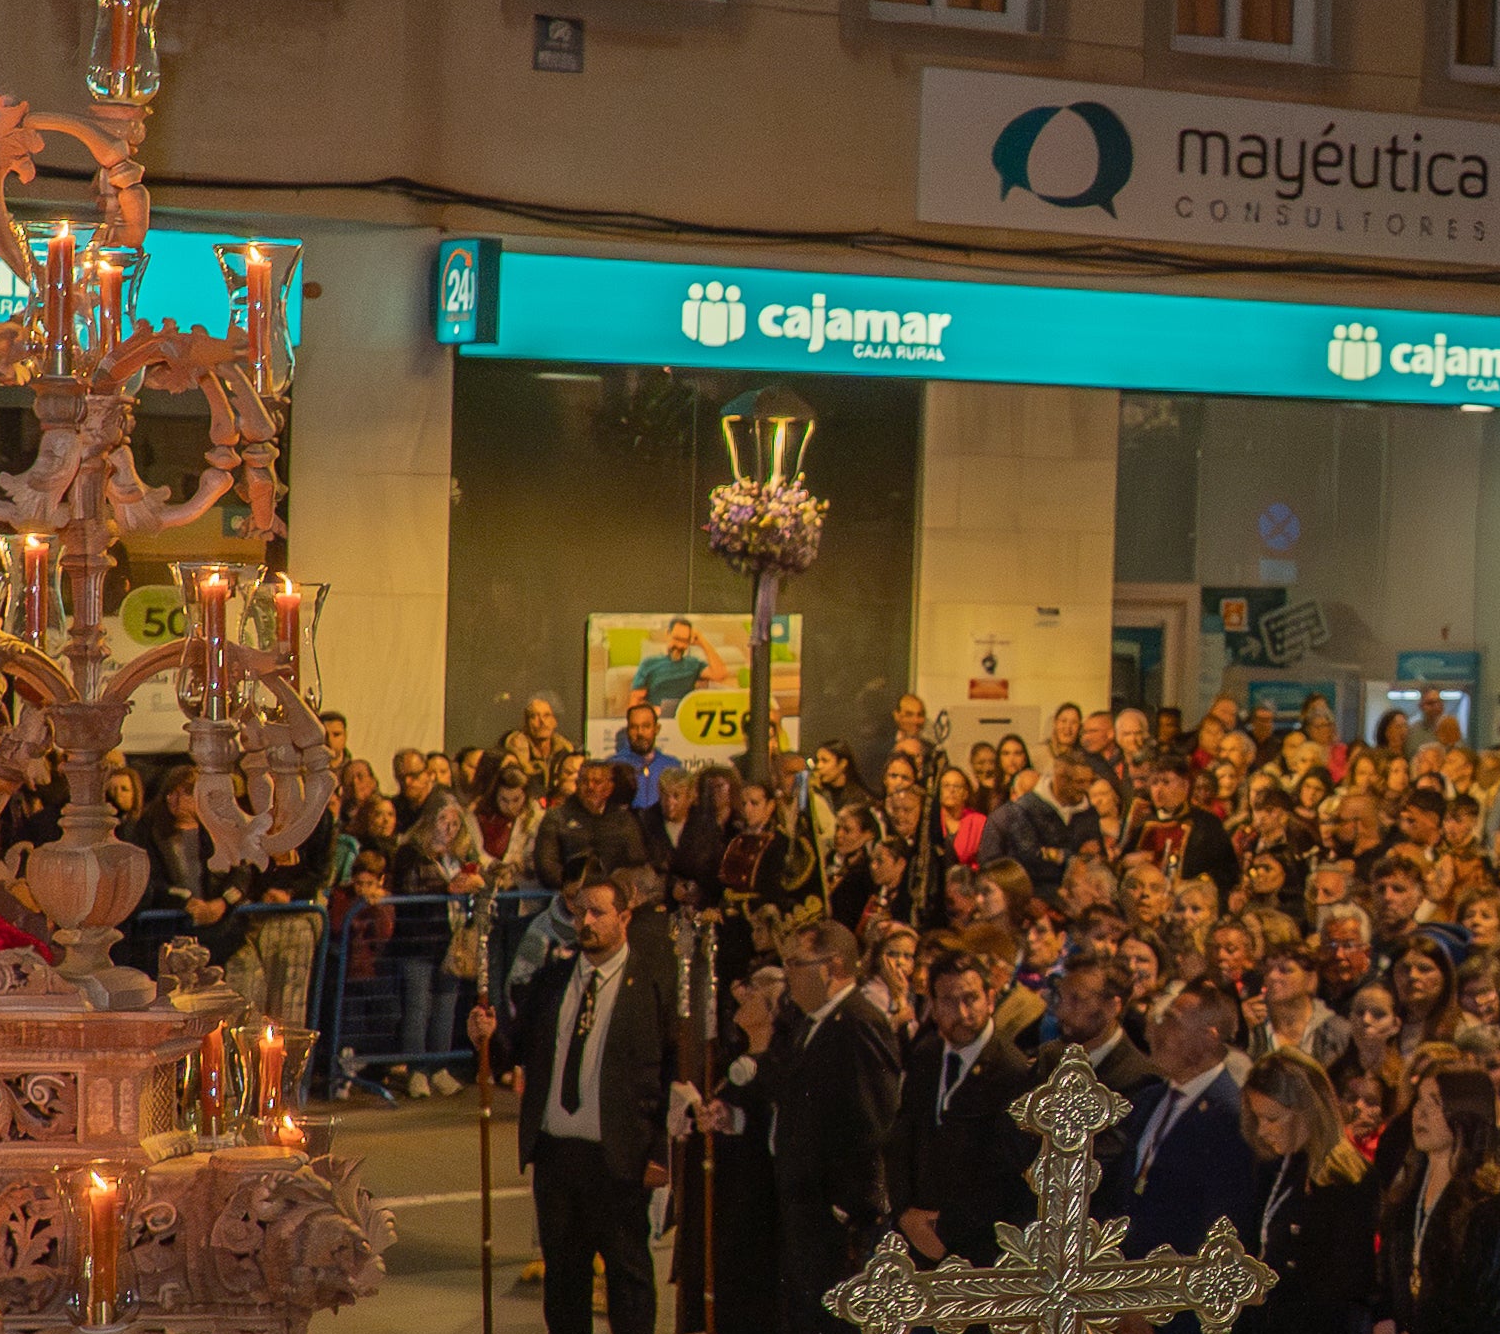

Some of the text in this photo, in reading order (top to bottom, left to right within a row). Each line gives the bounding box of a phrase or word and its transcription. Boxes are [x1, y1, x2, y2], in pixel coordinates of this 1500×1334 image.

[1176, 123, 1489, 200] mayéutica
[1174, 195, 1487, 243] CONSULTORES
[758, 293, 952, 354] cajamar
[853, 343, 946, 362] CAJA RURAL
[1466, 378, 1500, 393] CAJA
